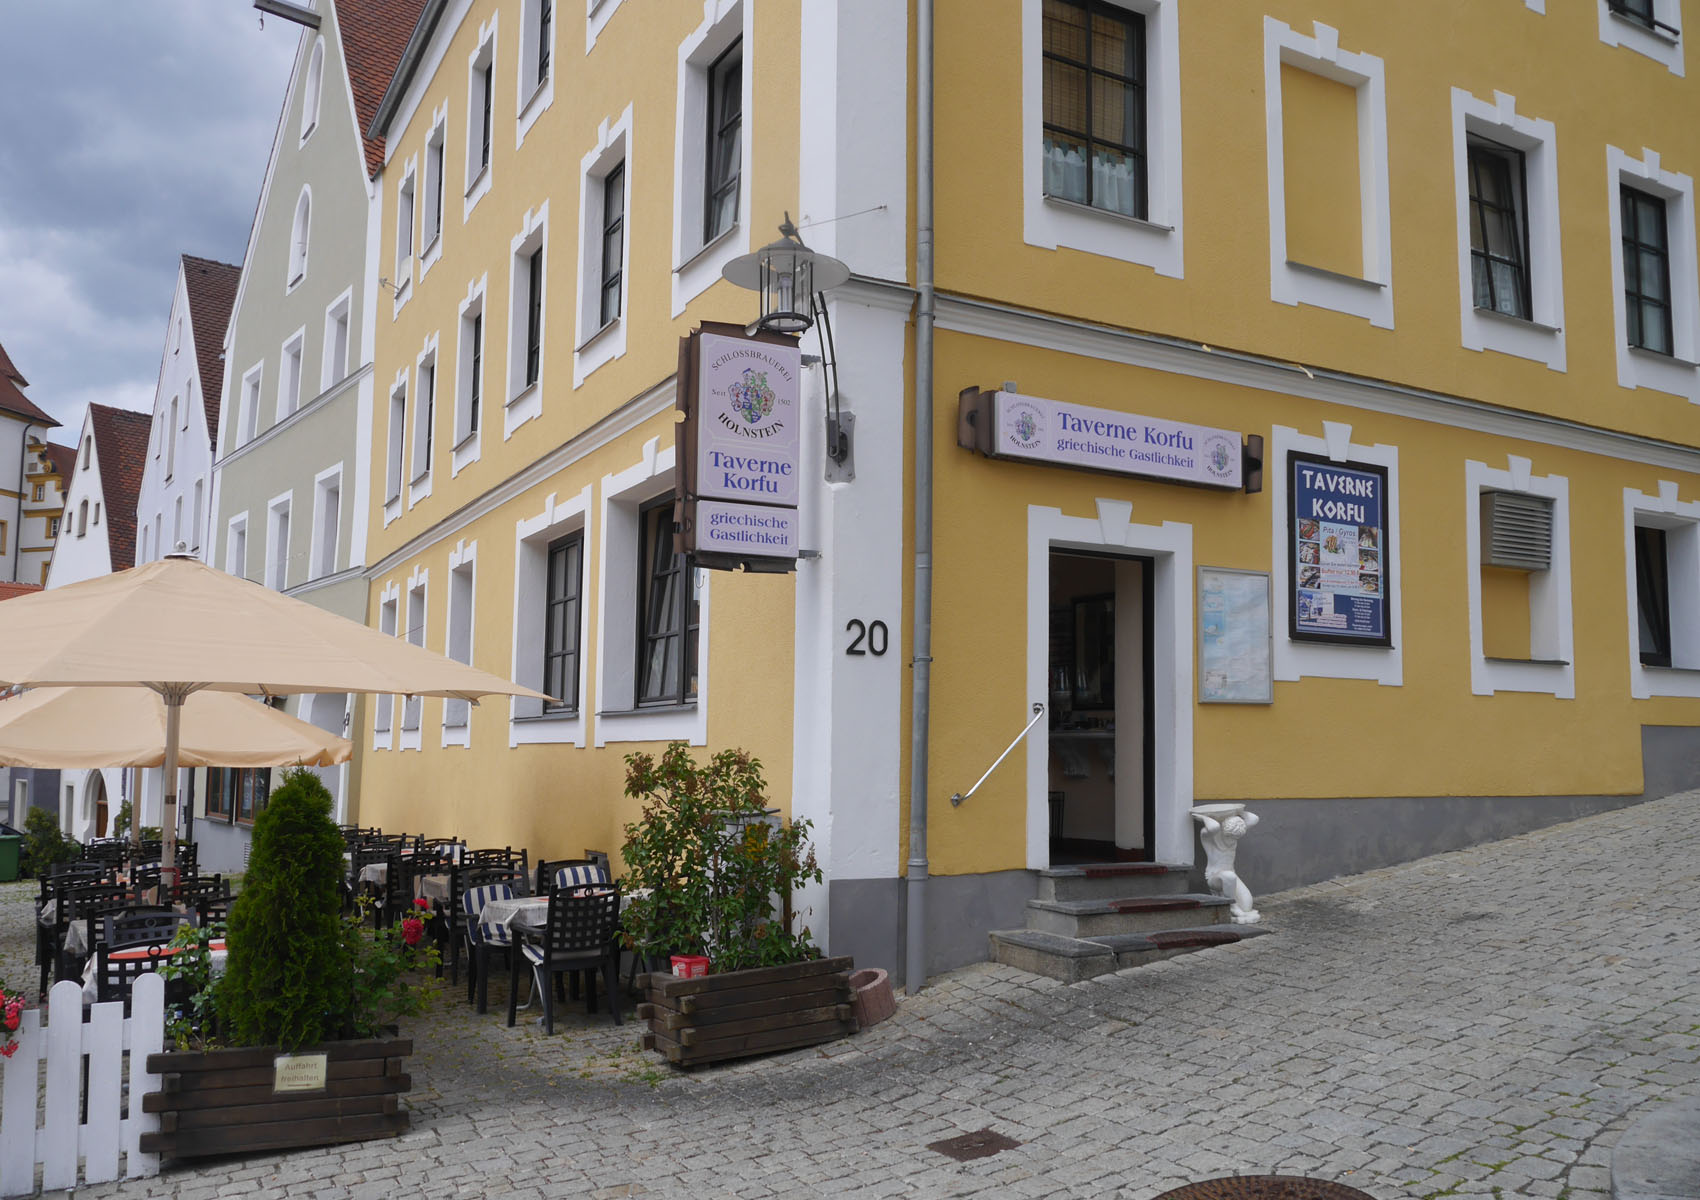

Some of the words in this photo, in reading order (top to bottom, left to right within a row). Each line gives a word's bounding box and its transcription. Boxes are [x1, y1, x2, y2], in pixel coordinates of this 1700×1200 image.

[711, 349, 792, 383] SCHLOSSBRAUEREI
[711, 389, 727, 397] Seit
[717, 411, 784, 439] HOLNSTEIN
[1057, 411, 1137, 441] Taverne
[1144, 426, 1193, 451] Korfu
[709, 451, 792, 476] Taverne
[1056, 437, 1126, 458] griechische
[1128, 448, 1194, 469] Gastlichkeit
[723, 472, 778, 493] Korfu
[1302, 469, 1374, 499] TAVERNE
[710, 512, 788, 529] griechische
[1312, 497, 1365, 524] KORFU
[709, 528, 789, 546] Gastlichkeit
[1338, 528, 1356, 537] Gyros
[846, 618, 889, 656] 20
[284, 1062, 318, 1071] Auffahrt
